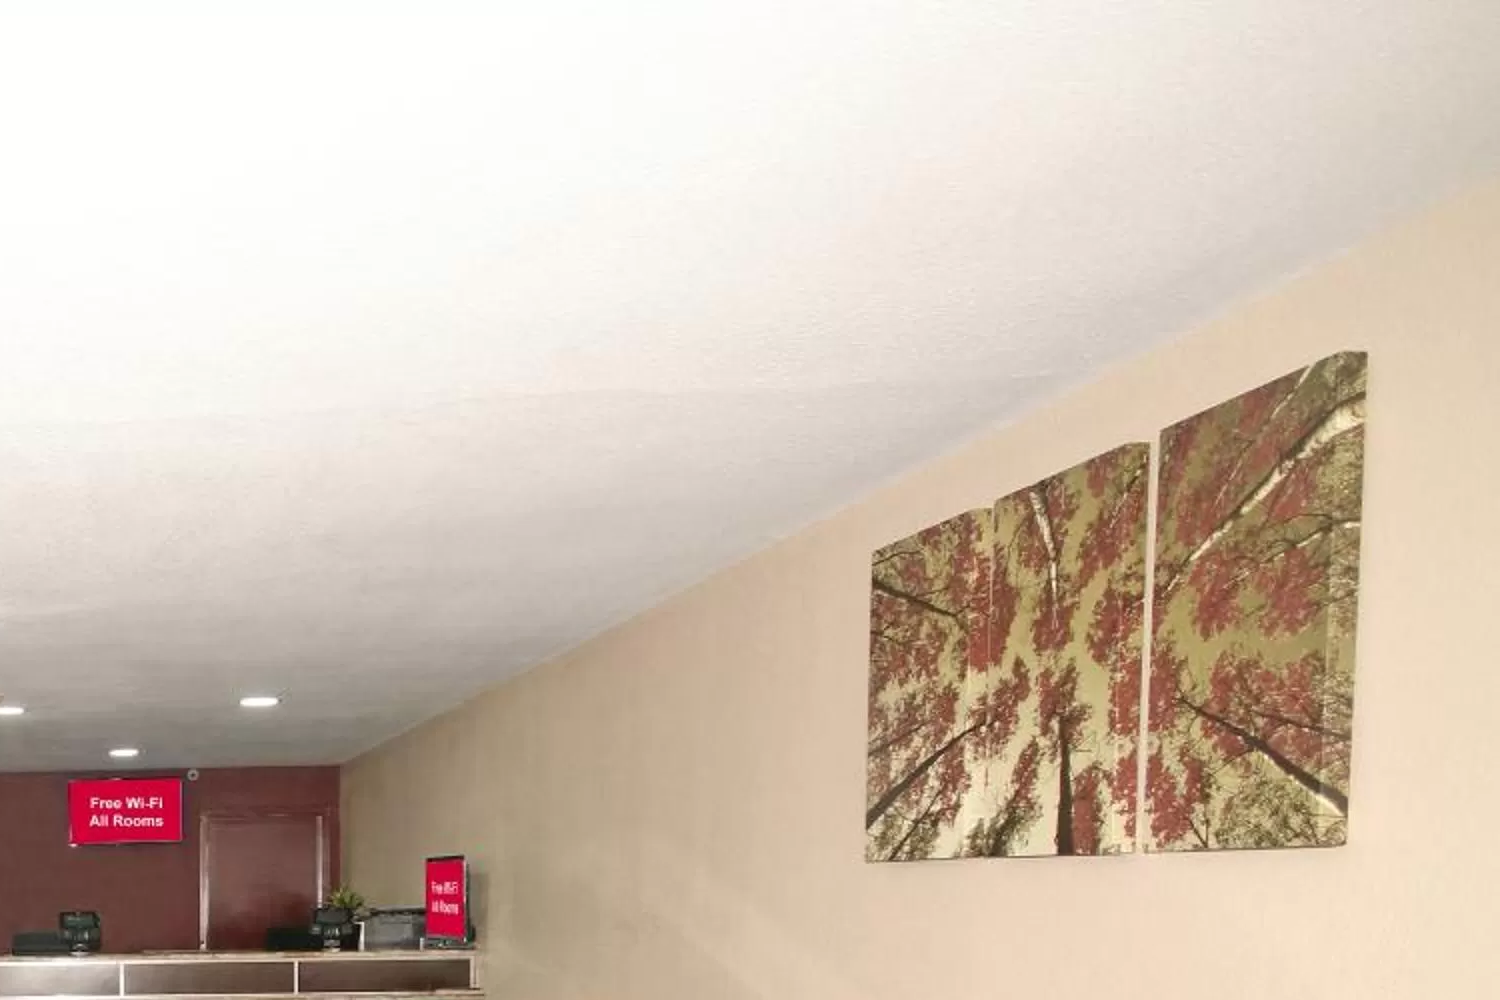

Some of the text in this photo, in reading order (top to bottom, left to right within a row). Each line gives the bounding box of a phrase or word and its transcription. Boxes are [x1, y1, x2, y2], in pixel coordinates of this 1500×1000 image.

[89, 796, 163, 809] Free Wi-Fi
[89, 814, 164, 827] All Rooms
